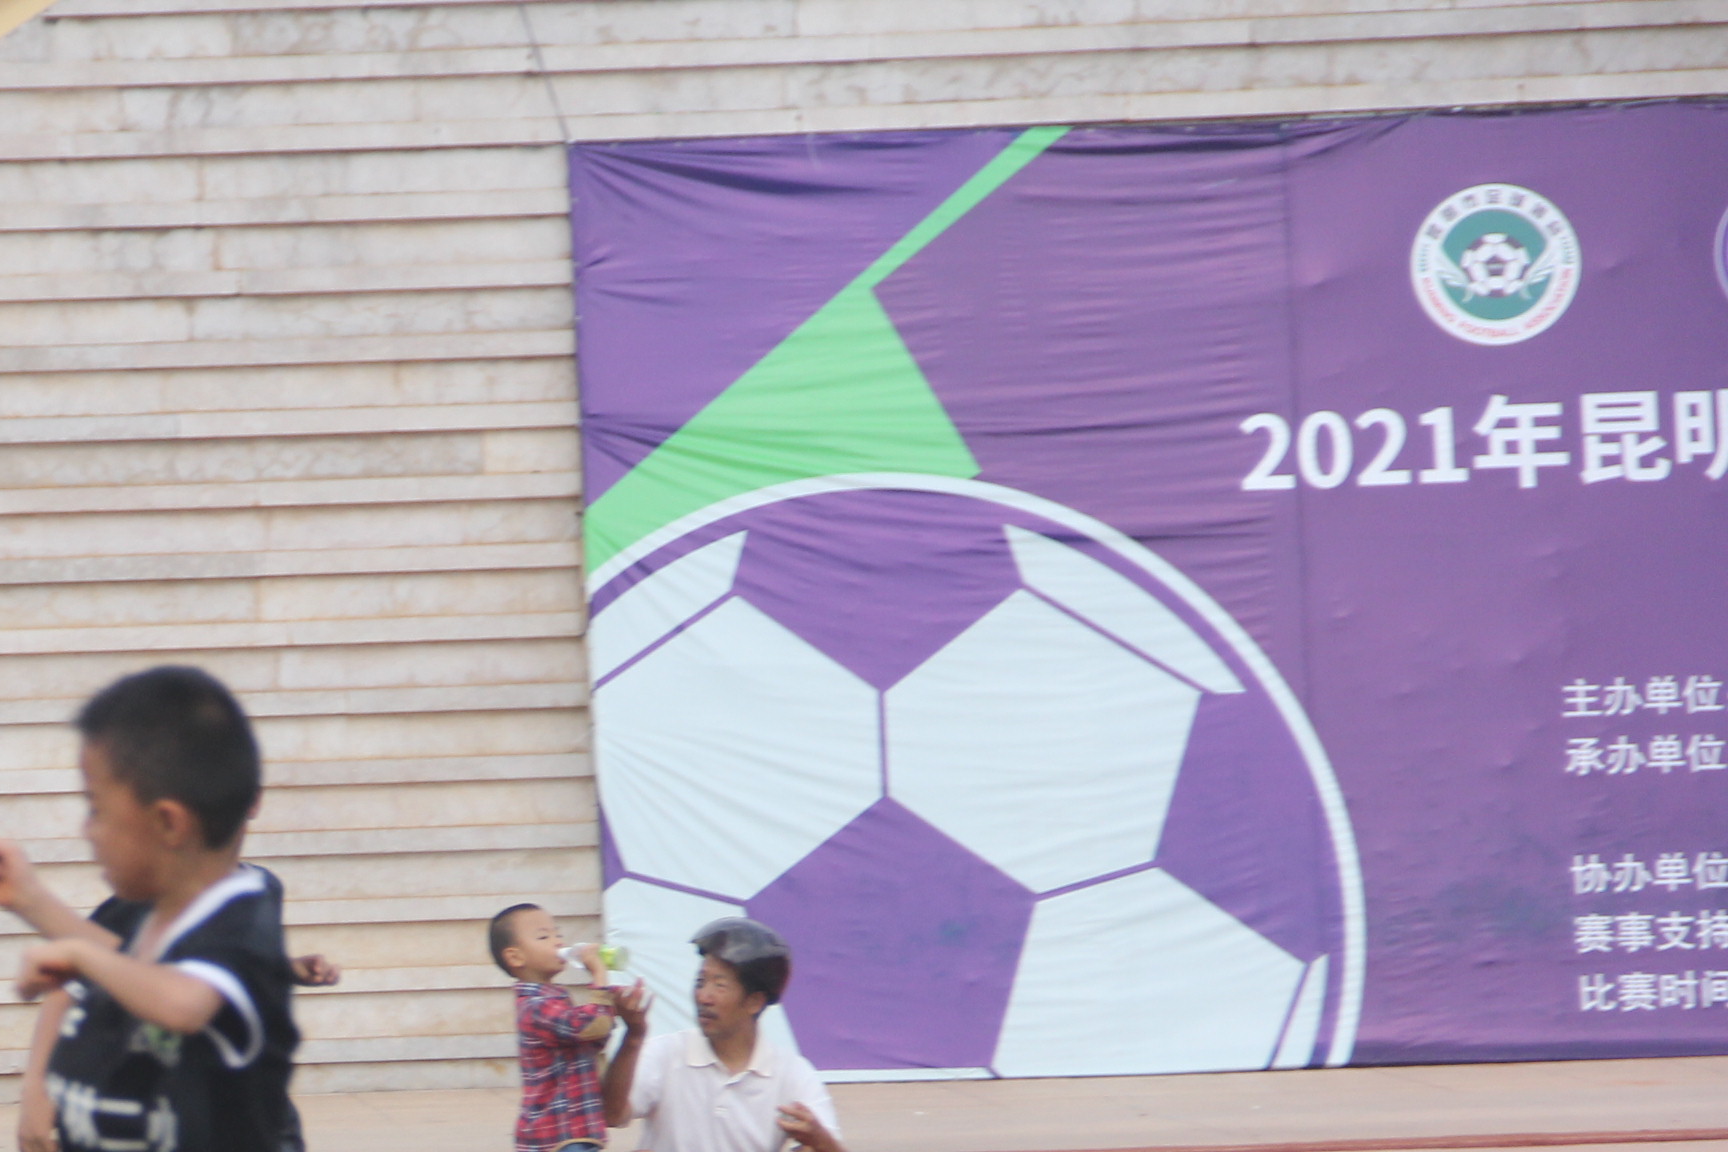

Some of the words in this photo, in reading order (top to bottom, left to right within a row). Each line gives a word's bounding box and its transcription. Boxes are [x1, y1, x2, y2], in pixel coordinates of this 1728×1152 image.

[1239, 388, 1728, 491] 2021年昆明
[1562, 675, 1725, 718] 主办单位
[1565, 734, 1728, 776] 承办单位
[1570, 852, 1728, 894] 协办单位
[1574, 910, 1728, 954] 赛事支持
[1577, 970, 1728, 1013] 比赛时间
